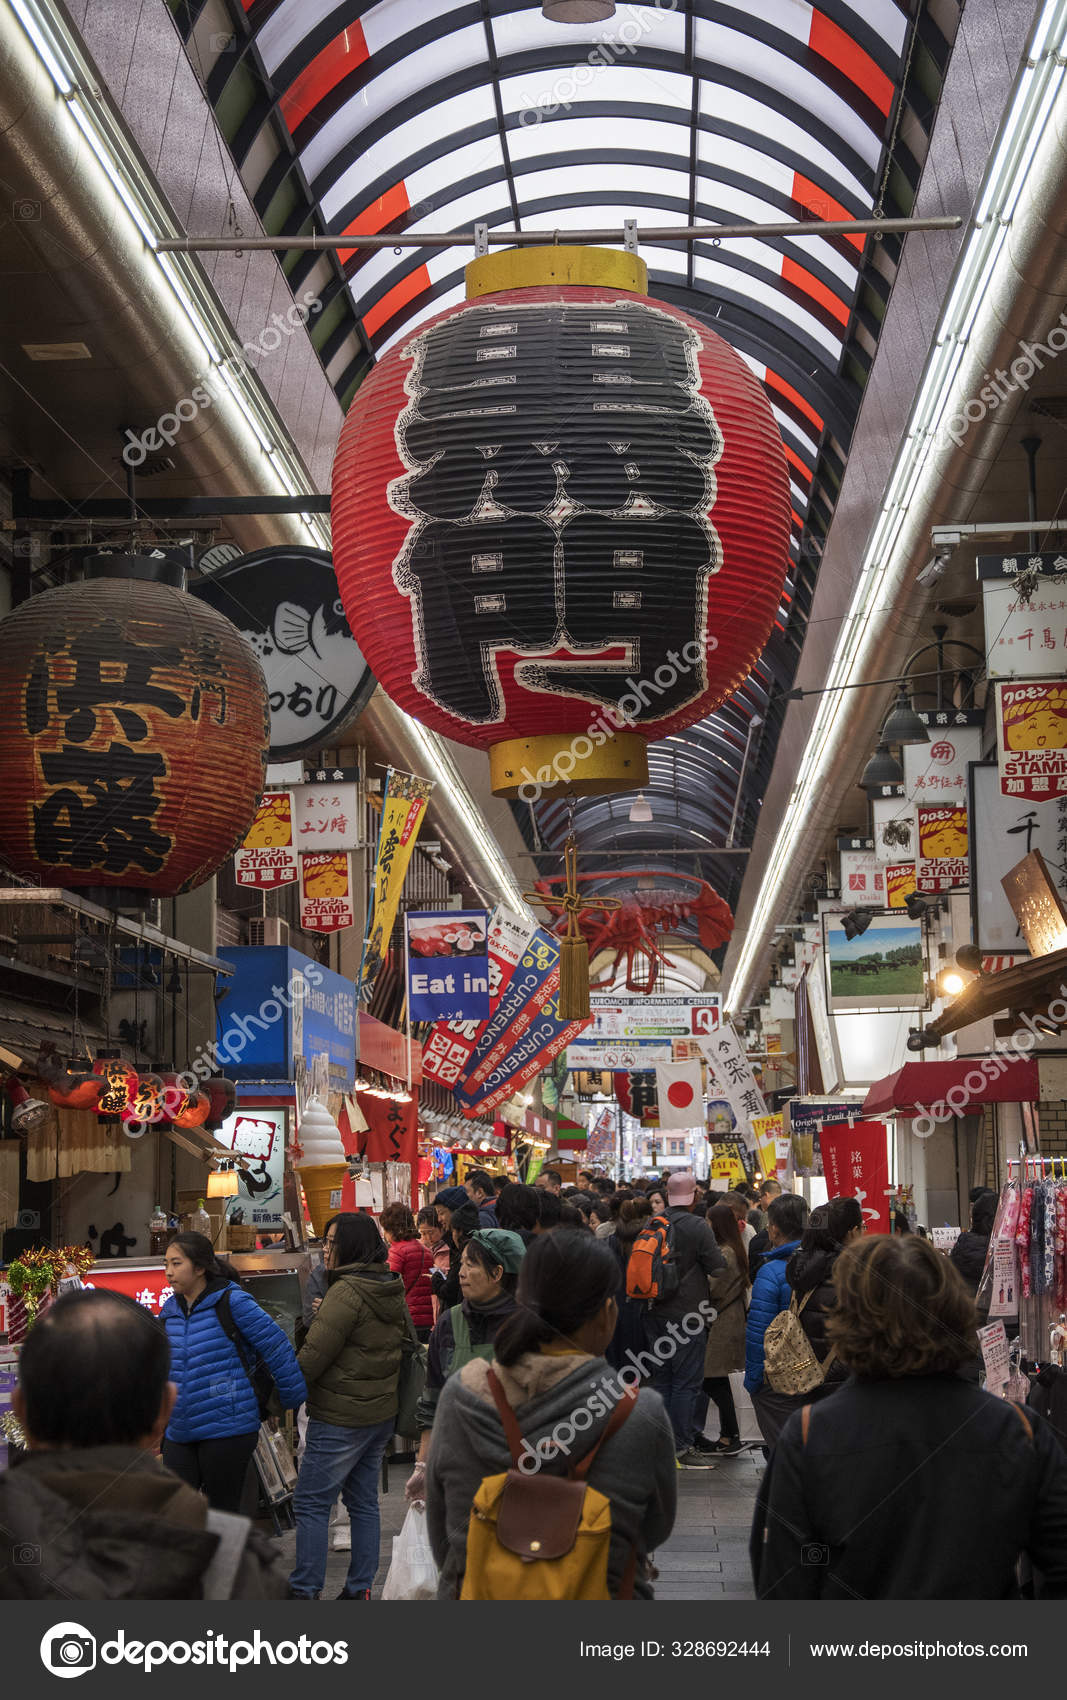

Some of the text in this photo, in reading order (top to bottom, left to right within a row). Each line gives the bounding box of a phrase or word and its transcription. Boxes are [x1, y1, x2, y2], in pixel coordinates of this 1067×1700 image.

[1017, 627, 1067, 651] 千鳥
[1003, 686, 1047, 704] クロモン
[305, 796, 341, 807] まぐろ
[300, 814, 349, 835] エン時
[244, 848, 287, 858] フレッシュ
[239, 856, 293, 869] STAMP
[303, 856, 333, 867] クロモン
[240, 867, 295, 882] 加盟店
[304, 904, 349, 914] STAMP
[305, 914, 350, 926] 加盟店
[412, 974, 455, 994] Eat
[463, 973, 488, 993] in
[590, 997, 715, 1006] KUROMON INFORMATION CENTER
[475, 974, 538, 1057] CURRENCY
[482, 1022, 555, 1092] CURRENCY
[847, 1108, 863, 1117] Juic
